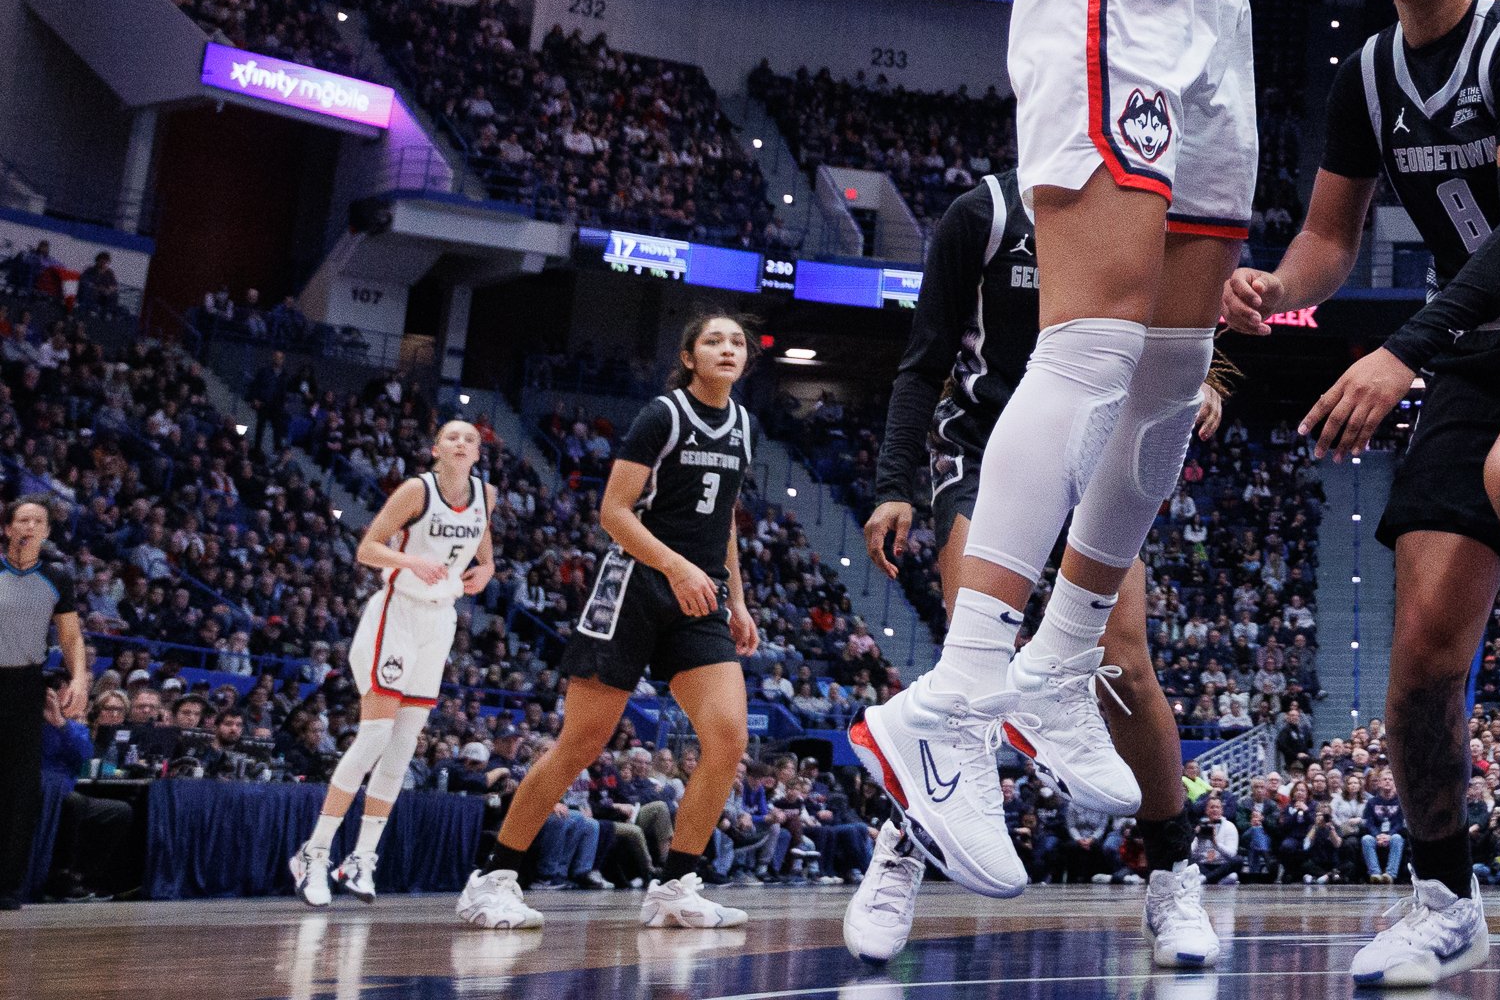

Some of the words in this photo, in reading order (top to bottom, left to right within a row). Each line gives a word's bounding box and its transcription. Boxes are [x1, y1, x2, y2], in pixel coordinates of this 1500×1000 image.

[871, 48, 907, 69] 233
[230, 60, 299, 98] xfinity
[1457, 94, 1482, 106] CHANGE
[1467, 86, 1480, 95] THE
[1436, 178, 1493, 254] 8
[610, 236, 637, 258] 17
[695, 472, 720, 514] 3
[444, 545, 464, 567] 5
